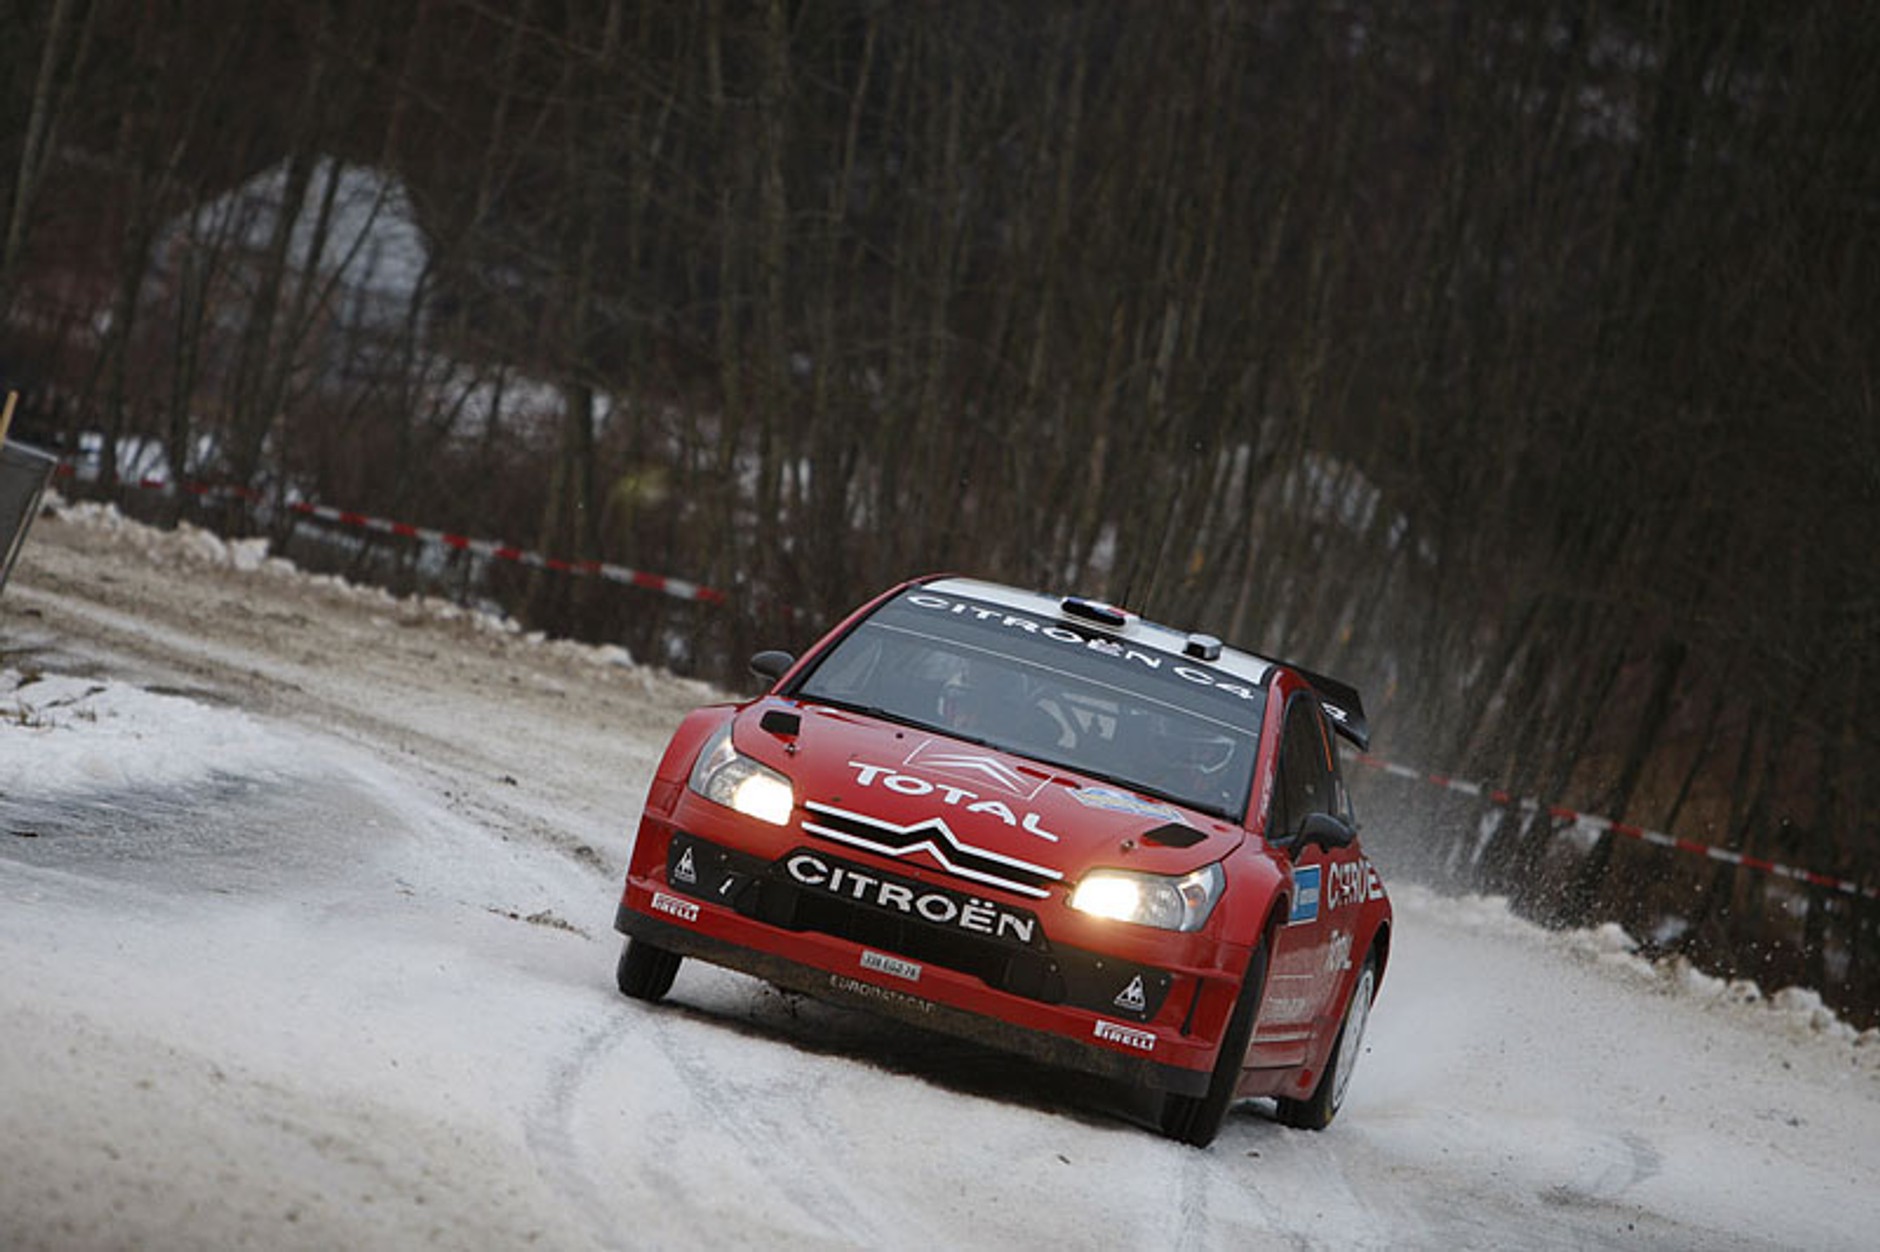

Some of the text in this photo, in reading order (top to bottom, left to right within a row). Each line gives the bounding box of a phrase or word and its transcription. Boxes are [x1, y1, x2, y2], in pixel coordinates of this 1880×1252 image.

[907, 596, 1254, 700] CITROËN C4
[848, 760, 1060, 843] TOTAL
[651, 891, 700, 922] PIRELLI
[787, 855, 1034, 943] CITROËN
[1093, 1019, 1158, 1052] PIRELLI
